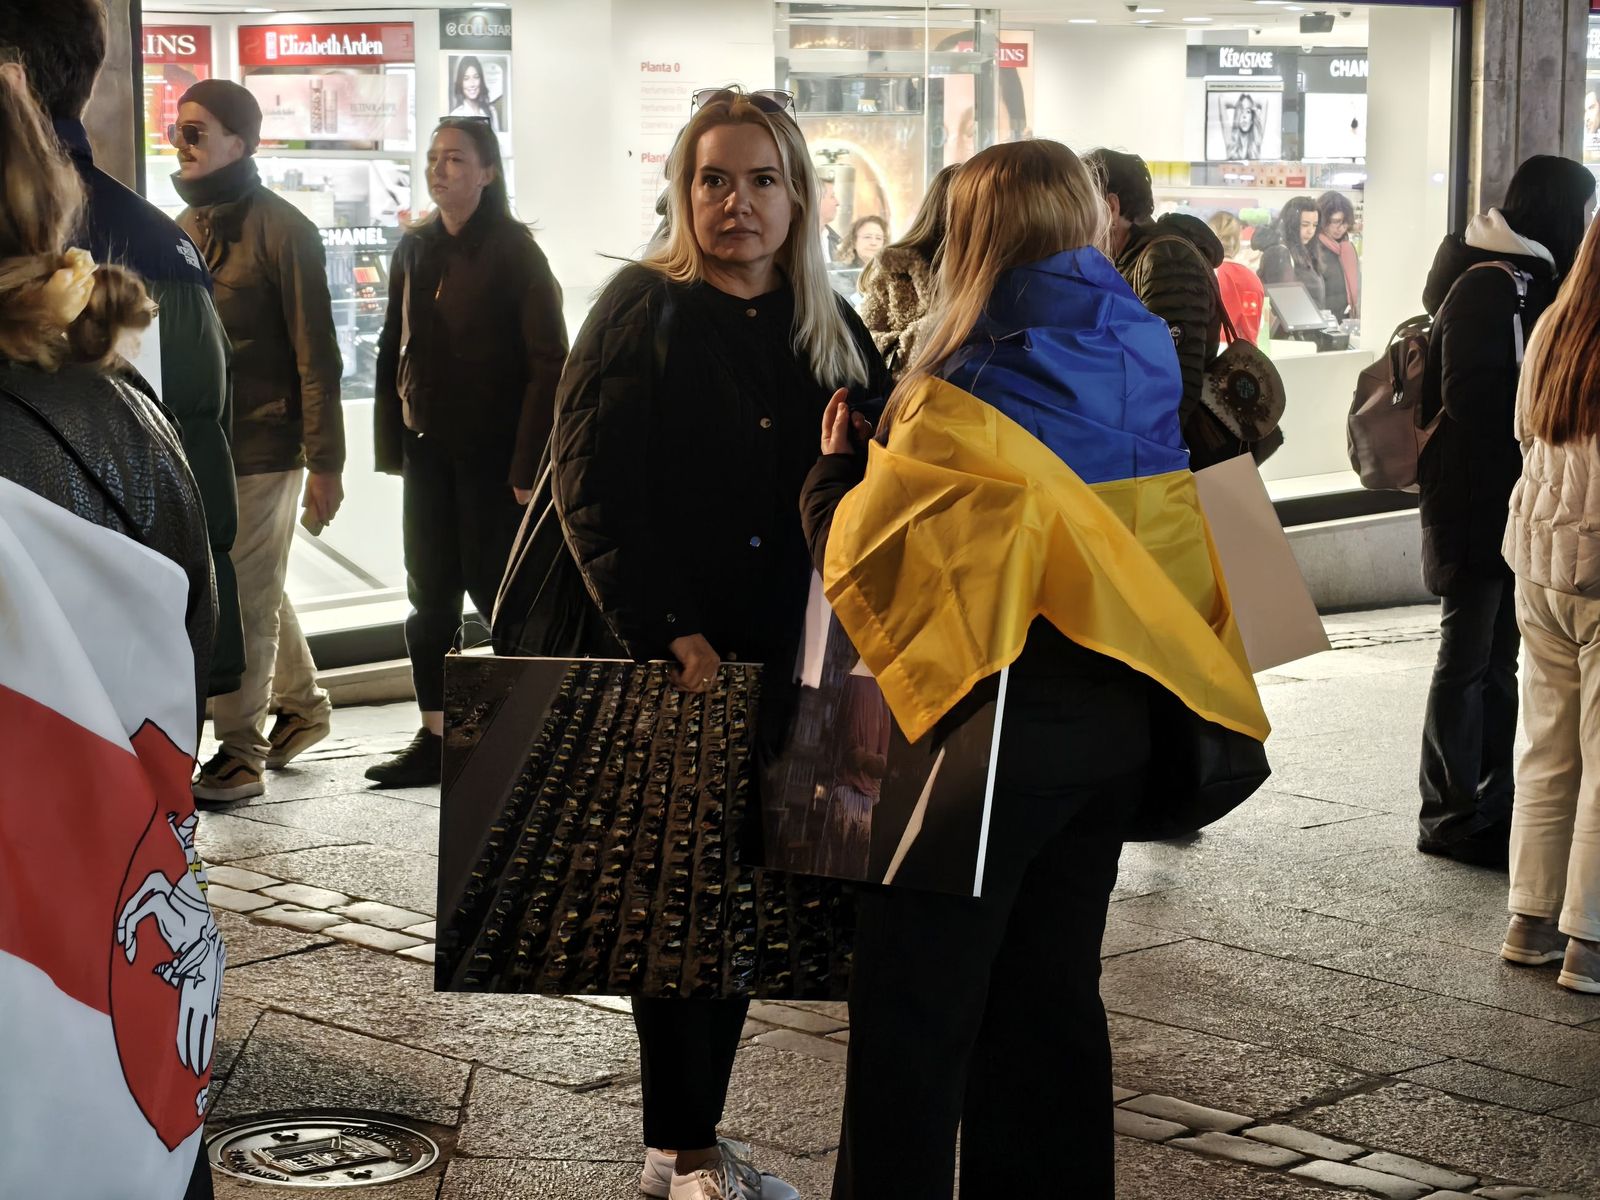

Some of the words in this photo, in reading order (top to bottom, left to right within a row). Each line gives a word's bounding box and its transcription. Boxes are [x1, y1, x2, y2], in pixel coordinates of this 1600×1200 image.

[142, 34, 196, 55] INS
[279, 33, 342, 56] Elizabeth
[341, 33, 383, 55] Arden
[641, 61, 672, 73] Planta
[674, 62, 681, 73] 0
[641, 152, 668, 164] Plant
[319, 227, 387, 246] CHANEL
